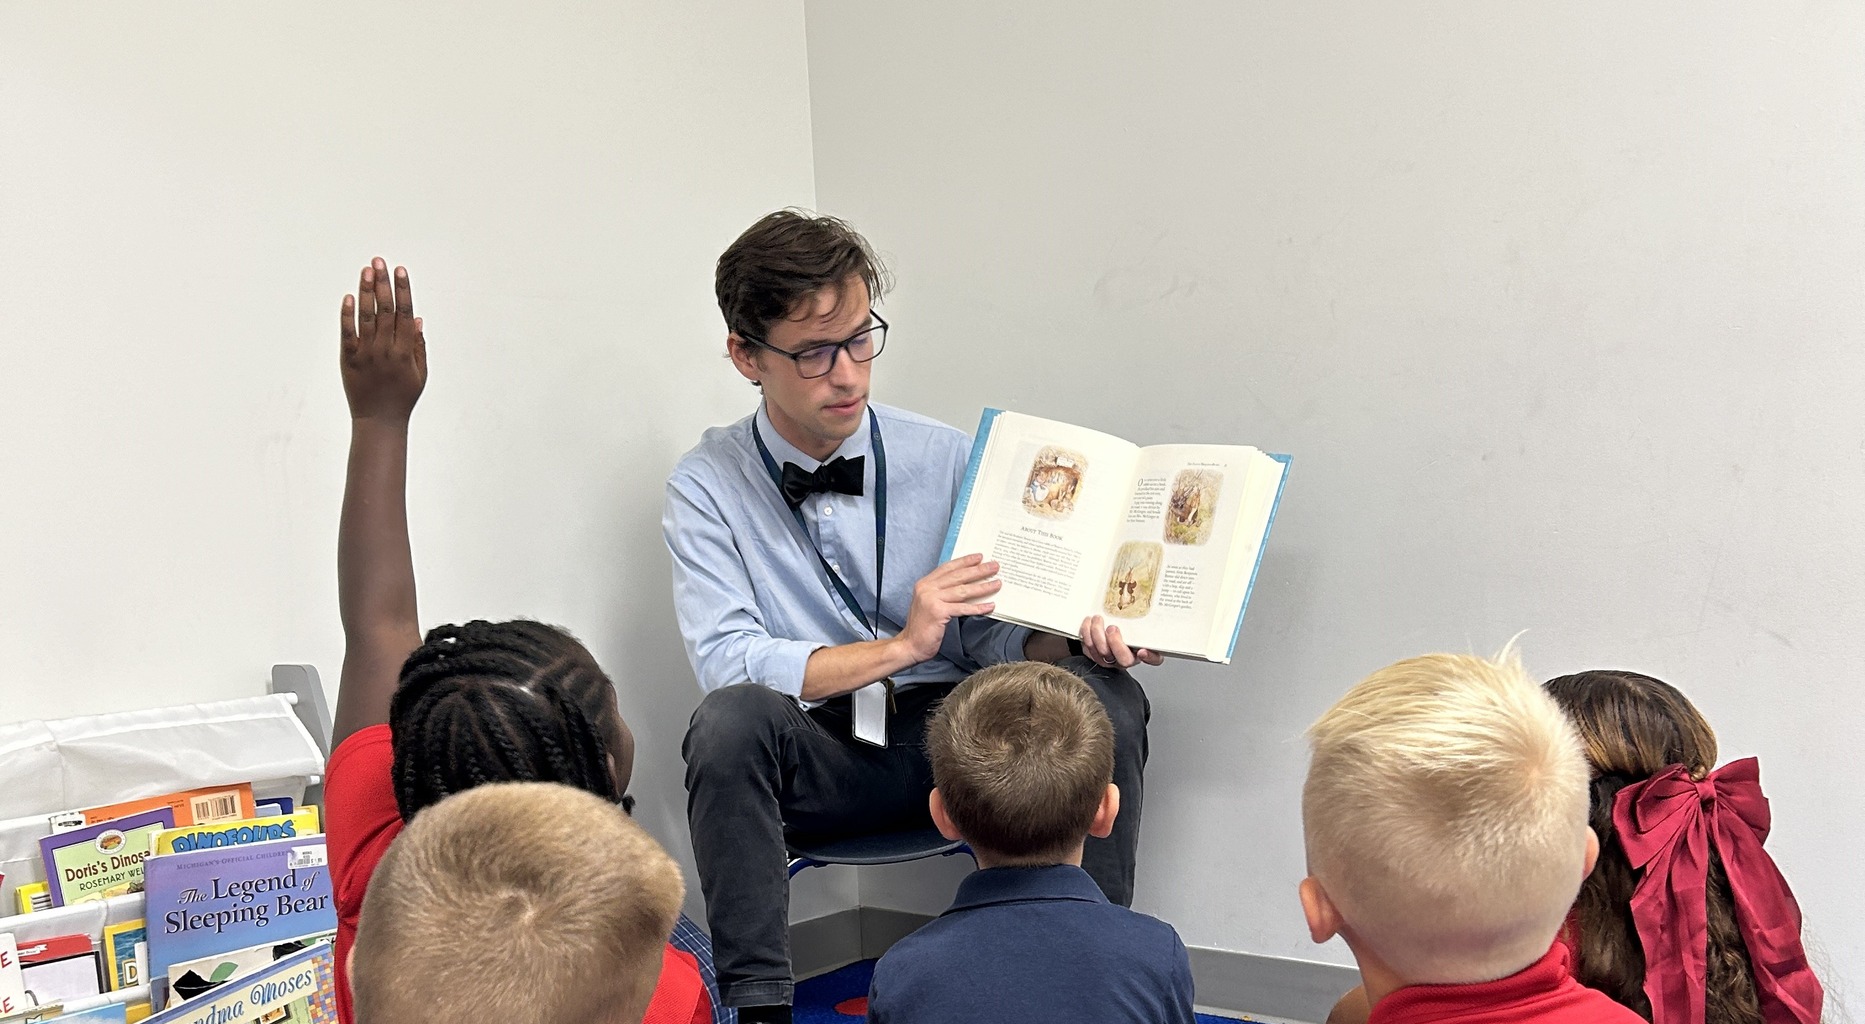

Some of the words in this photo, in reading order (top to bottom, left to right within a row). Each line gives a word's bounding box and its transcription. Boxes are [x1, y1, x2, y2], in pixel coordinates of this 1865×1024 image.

[65, 860, 108, 881] Doris's
[79, 872, 125, 891] ROSEMARY
[177, 888, 208, 905] The
[211, 869, 297, 903] Legend
[301, 871, 320, 892] of
[164, 903, 269, 934] Sleeping
[275, 894, 329, 917] Bear
[250, 969, 312, 1006] Moses
